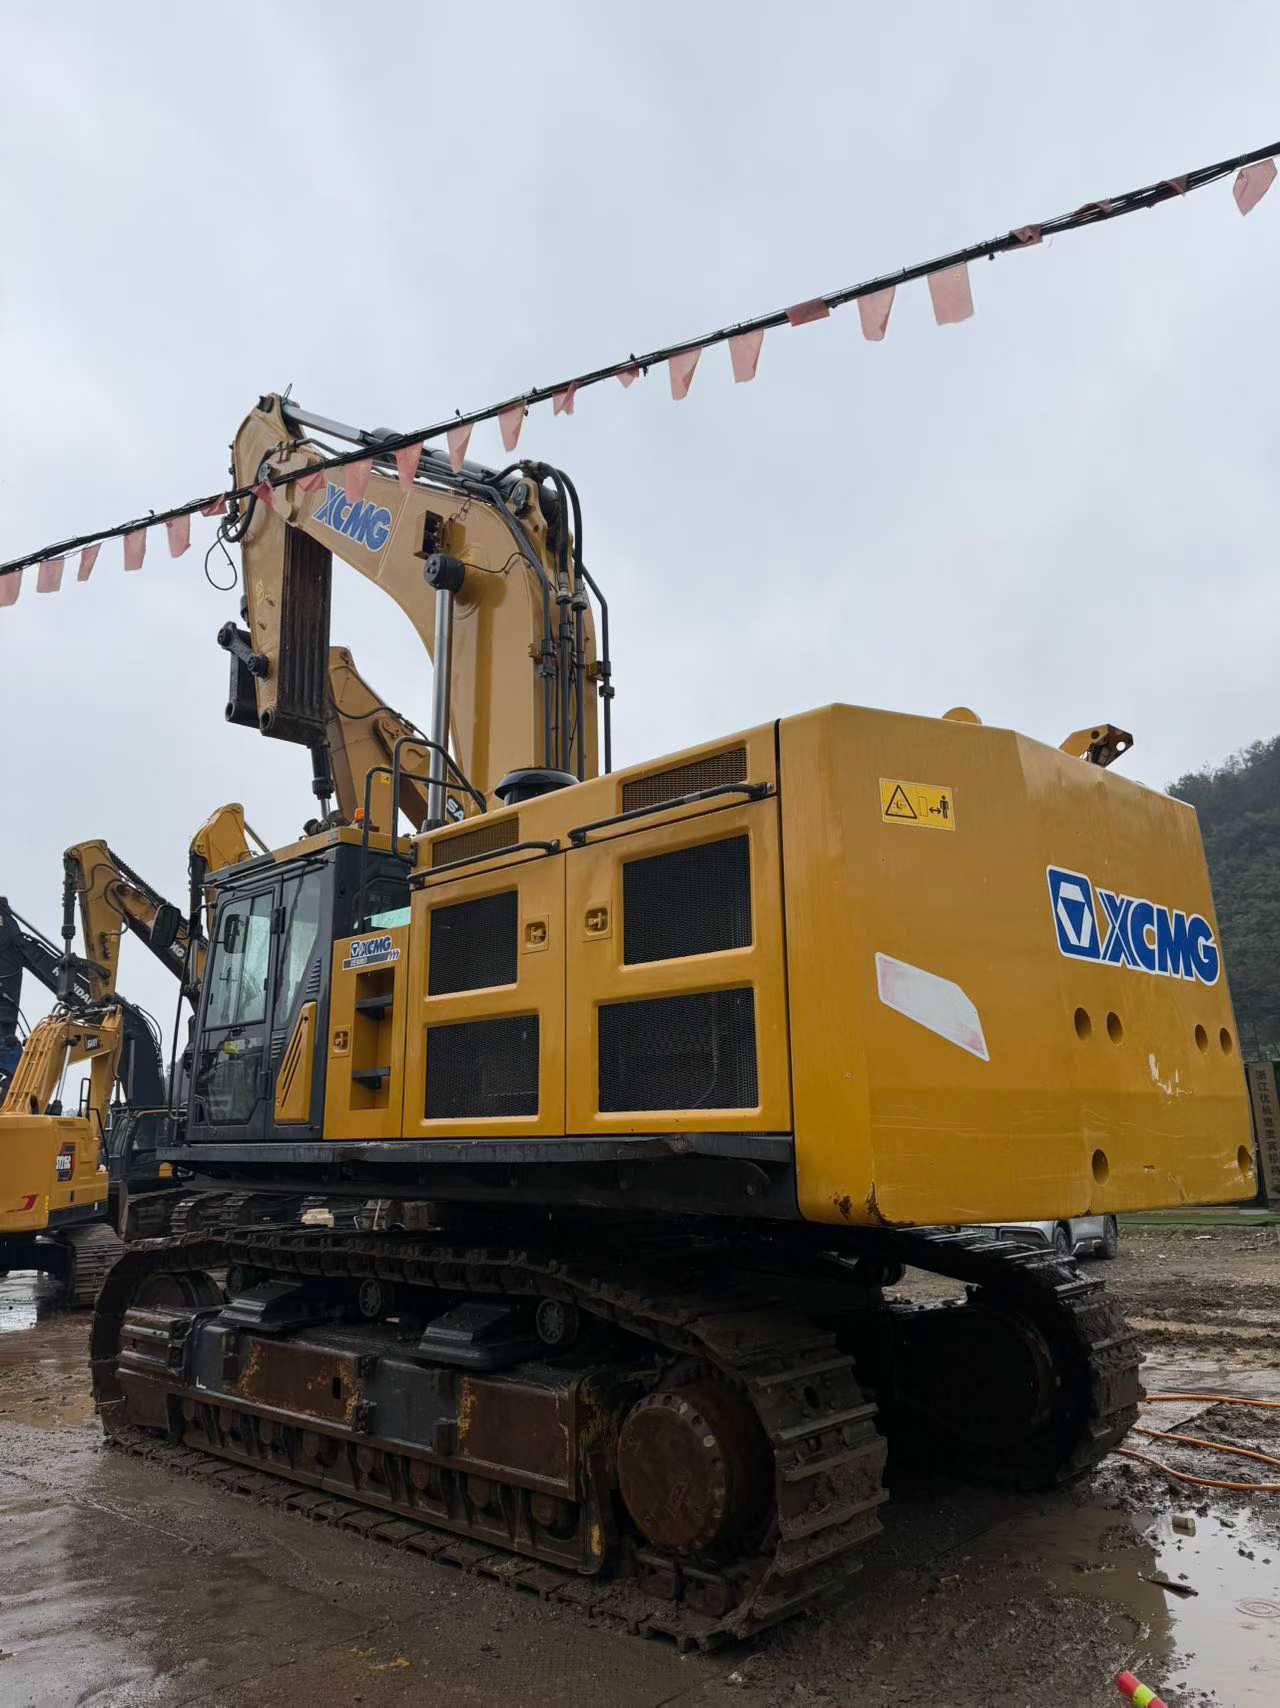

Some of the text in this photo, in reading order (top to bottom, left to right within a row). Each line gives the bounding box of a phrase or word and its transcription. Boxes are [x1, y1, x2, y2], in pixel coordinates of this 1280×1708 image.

[312, 481, 392, 552] XCMG
[447, 798, 465, 821] SA
[359, 935, 391, 957] XCMG
[1094, 886, 1220, 985] XCMG
